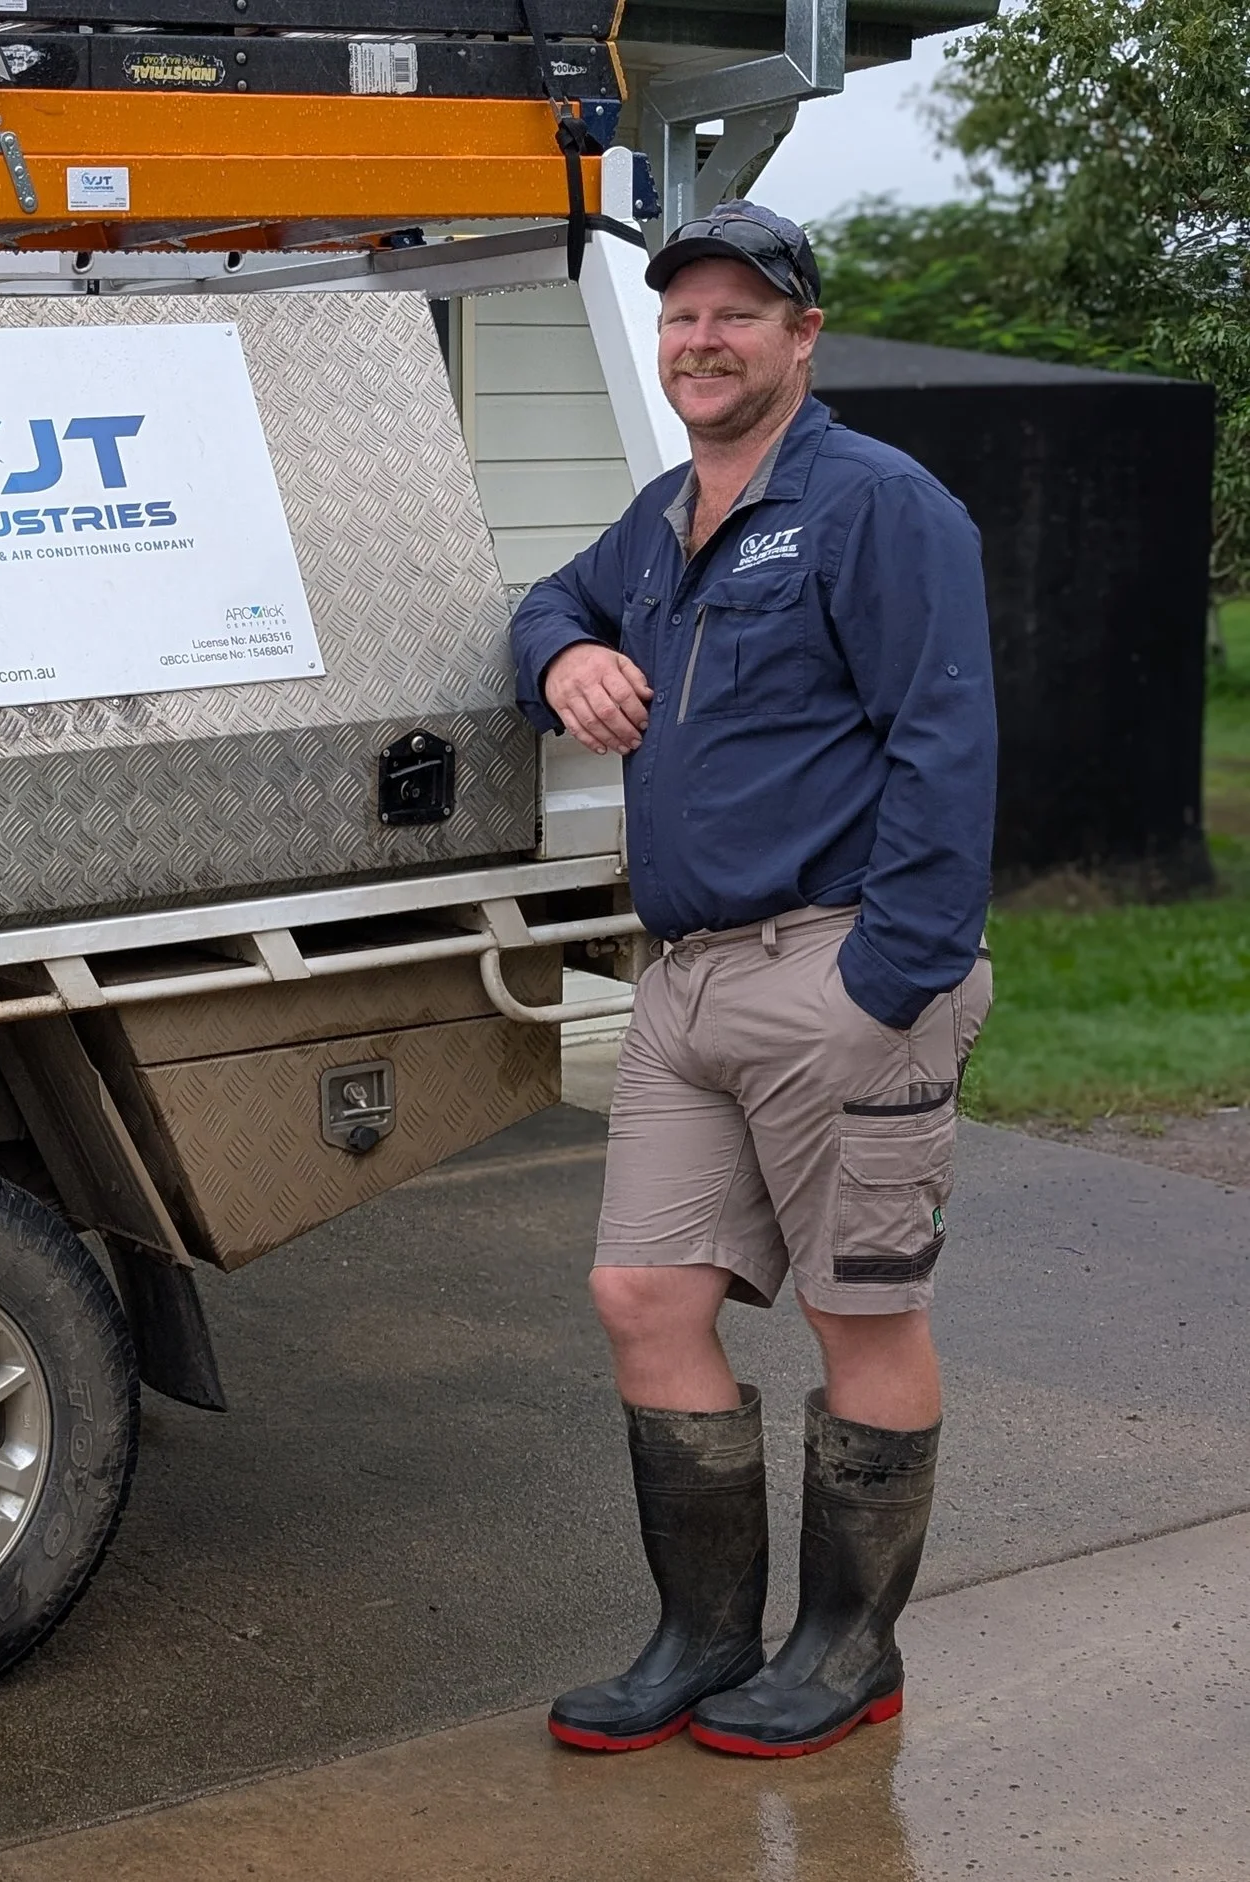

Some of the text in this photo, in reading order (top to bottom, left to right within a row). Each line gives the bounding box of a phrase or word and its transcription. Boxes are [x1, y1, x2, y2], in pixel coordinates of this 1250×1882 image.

[131, 65, 217, 81] INDUSTRIAL
[0, 551, 8, 561] &
[11, 549, 33, 561] AIR
[36, 543, 131, 559] CONDITIONING
[134, 538, 195, 552] COMPANY
[748, 526, 805, 554] VJT
[226, 619, 287, 630] CERTIFIED
[192, 631, 292, 649] License No: AU63516
[159, 644, 294, 666] QBCC License No: 15468047
